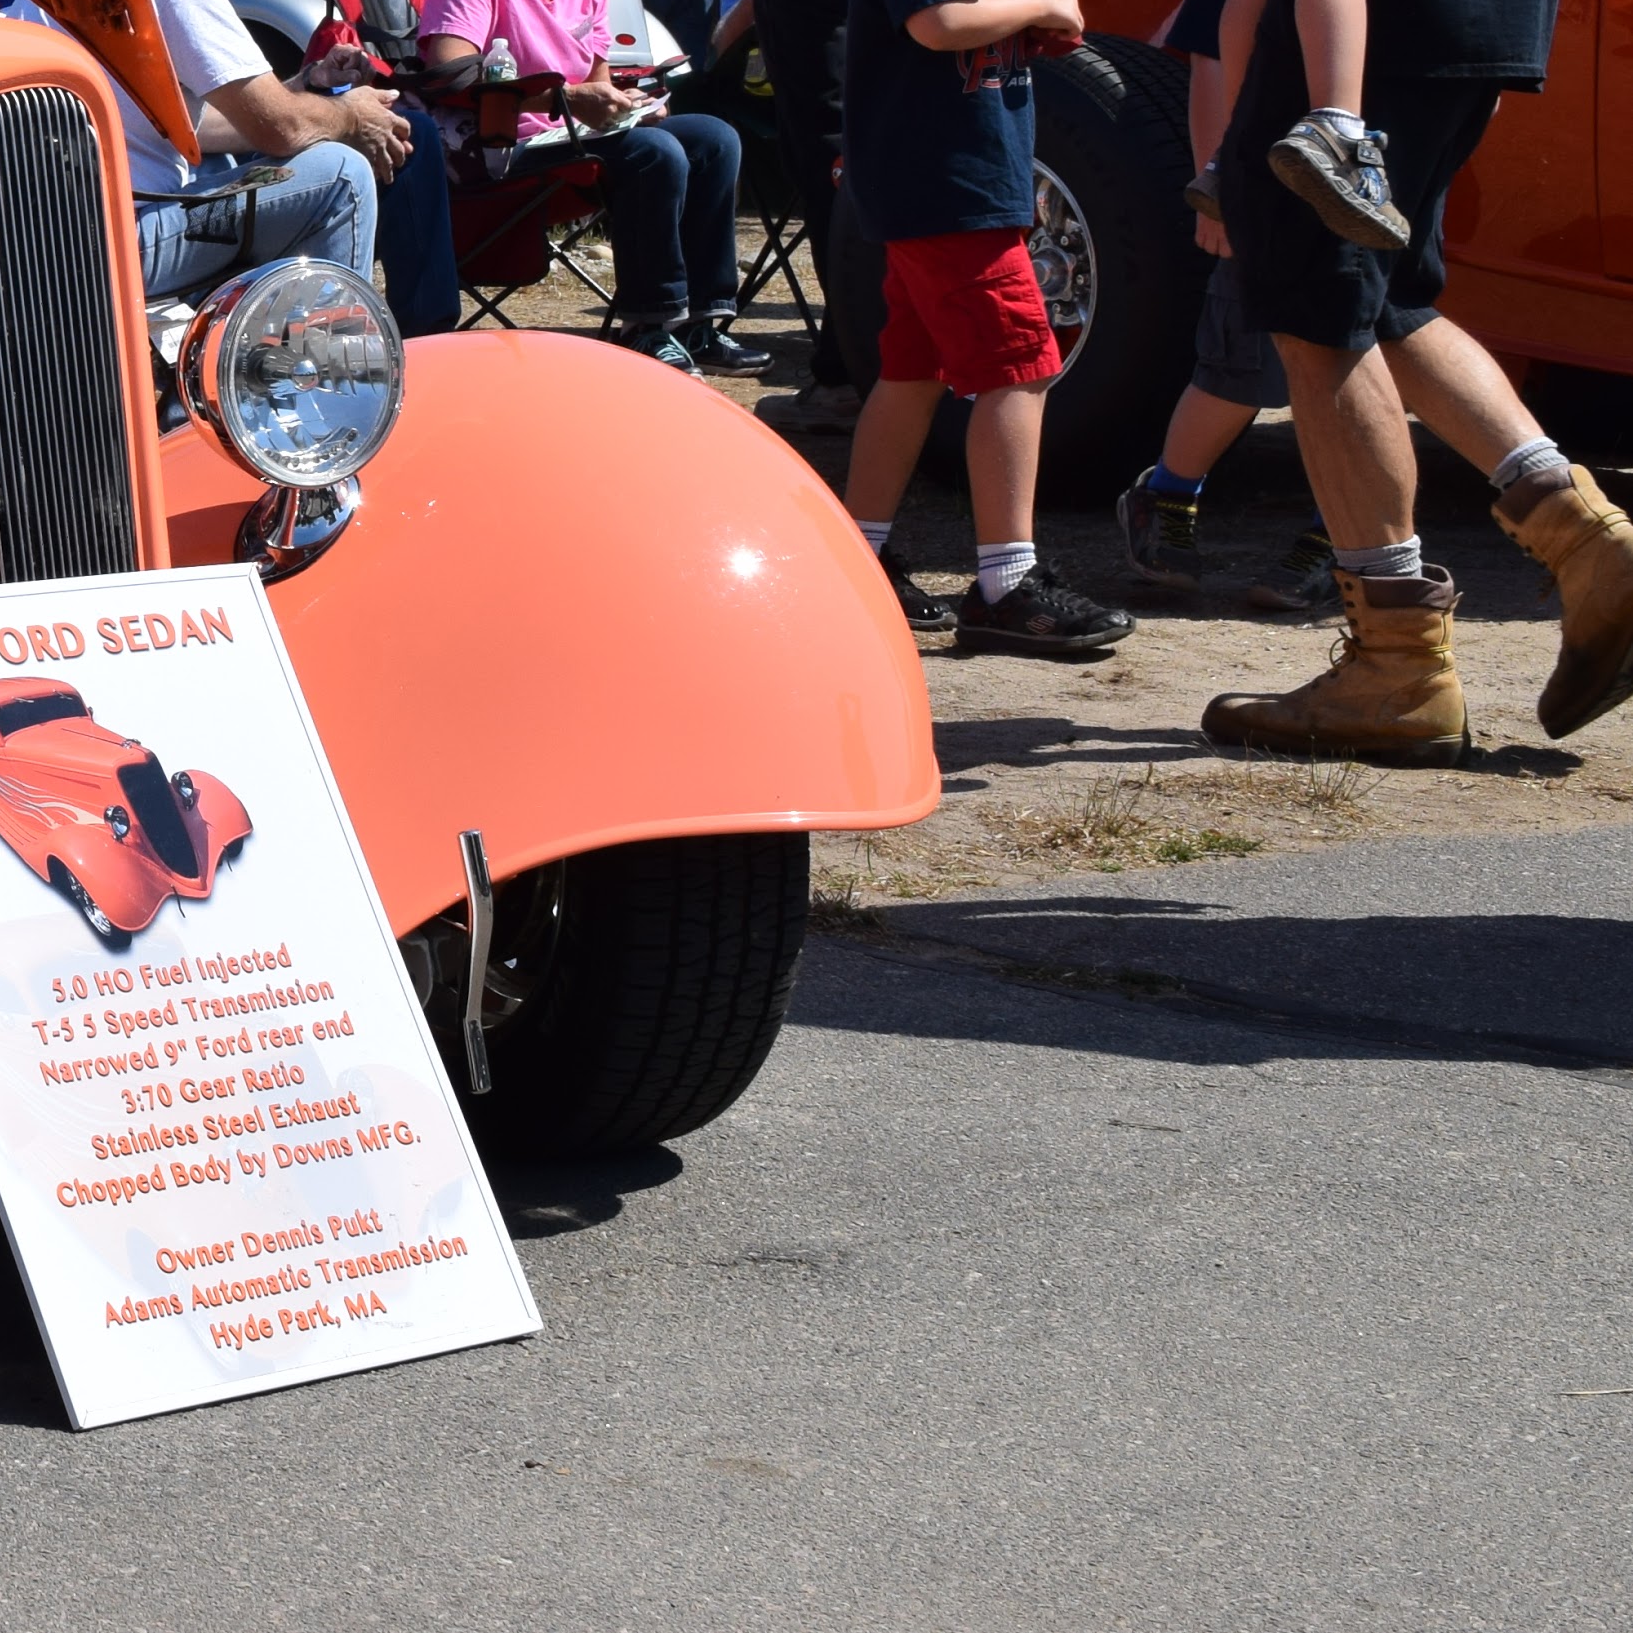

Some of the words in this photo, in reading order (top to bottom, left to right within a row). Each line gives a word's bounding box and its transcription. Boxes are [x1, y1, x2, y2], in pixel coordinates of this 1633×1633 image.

[96, 606, 235, 655] SEDAN
[52, 975, 89, 1002] 5.0
[94, 968, 134, 994] HO
[139, 959, 192, 988] Fuel
[196, 944, 292, 983] Injected
[33, 1017, 75, 1044] T-5
[83, 1013, 97, 1039] 5
[103, 999, 179, 1038] Speed
[182, 981, 334, 1021] Transmission
[39, 1043, 160, 1084] Narrowed
[195, 1027, 253, 1058] Ford
[257, 1025, 303, 1049] rear
[312, 1012, 354, 1040] end
[121, 1082, 174, 1114] 3:70
[178, 1075, 236, 1104] Gear
[241, 1060, 305, 1091] Ratio
[91, 1123, 199, 1160] Stainless
[201, 1106, 266, 1141] Steel
[268, 1092, 361, 1129] Exhaust
[55, 1163, 167, 1208] Chopped
[169, 1154, 232, 1188] Body
[236, 1151, 267, 1177] by
[272, 1136, 354, 1169] Downs
[356, 1119, 422, 1152] MFG.
[155, 1240, 235, 1274] Owner
[240, 1224, 325, 1258] Dennis
[327, 1210, 383, 1239] Pukt
[105, 1294, 184, 1325] Adams
[191, 1265, 312, 1309] Automatic
[315, 1236, 468, 1282] Transmission
[209, 1313, 275, 1350] Hyde
[277, 1300, 342, 1334] Park,
[343, 1291, 387, 1318] MA
